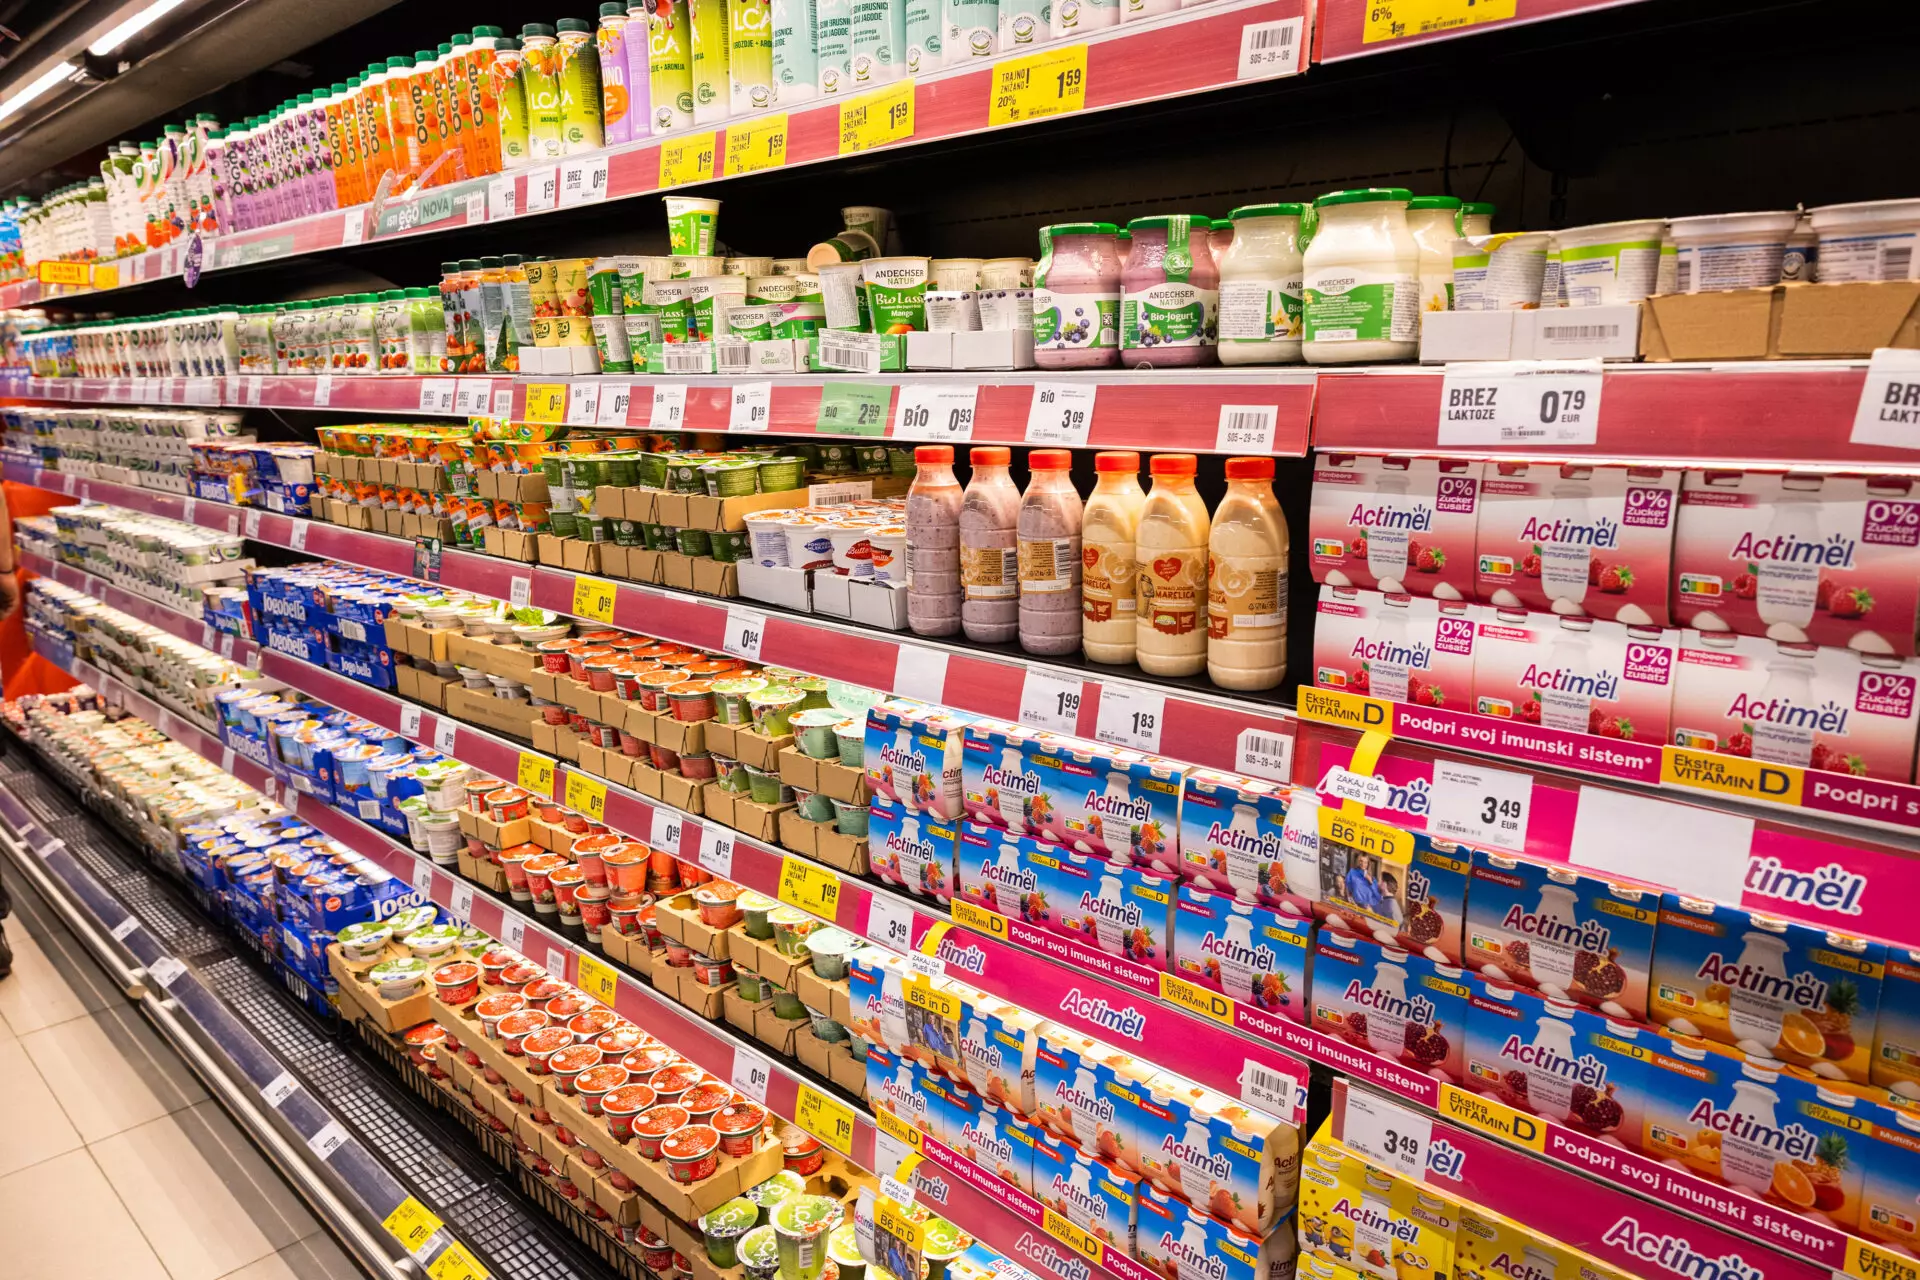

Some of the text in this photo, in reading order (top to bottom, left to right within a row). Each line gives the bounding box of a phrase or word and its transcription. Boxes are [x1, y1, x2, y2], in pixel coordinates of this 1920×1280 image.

[1371, 8, 1392, 22] 6%
[997, 96, 1016, 108] 20%
[1068, 87, 1080, 96] EUR
[567, 169, 582, 182] BREZ
[422, 198, 449, 217] NOVA
[875, 269, 924, 279] ANDECHSER
[887, 277, 915, 285] NATUR
[1149, 289, 1194, 299] ANDECHSER
[1159, 298, 1184, 307] NATUR
[890, 309, 913, 318] Mango
[1448, 386, 1498, 407] BREZ
[1447, 407, 1496, 421] LAKTOZE
[1560, 413, 1580, 423] EUR
[1438, 494, 1473, 504] Zucker
[1440, 479, 1474, 496] 0%
[1438, 502, 1472, 512] zusatz
[1627, 489, 1669, 510] 0%
[1350, 503, 1432, 531] Actimel
[1625, 514, 1667, 528] zusatz
[1626, 506, 1668, 519] Zucker
[1867, 502, 1919, 526] 0%
[1521, 517, 1618, 547] Actimel
[1732, 532, 1854, 568] Actimel
[1156, 590, 1195, 600] MARELICA
[1437, 634, 1471, 646] Zucker
[1440, 620, 1472, 638] 0%
[1352, 636, 1431, 669] Actimel
[1436, 642, 1470, 653] zusatz
[1628, 645, 1669, 666] 0%
[1626, 662, 1668, 675] Zucker
[1626, 670, 1666, 683] zusatz
[1520, 664, 1619, 700] Actimel
[1862, 674, 1911, 697] 0%
[1305, 693, 1340, 708] Ekstra
[1305, 702, 1384, 725] VITAMIN D
[1727, 692, 1848, 734] Actimel
[1400, 712, 1456, 735] Podpri
[1461, 726, 1496, 746] svoj
[1502, 732, 1574, 756] imunski
[880, 743, 925, 773] Actimel
[1674, 753, 1725, 773] Ekstra
[983, 764, 1040, 793] Actimel
[1336, 774, 1380, 793] ZAKAJ GA
[1674, 767, 1791, 795] VITAMIN D
[1084, 790, 1151, 821] Actimel
[1813, 782, 1899, 811] Podpri
[1207, 823, 1281, 862] Actimel
[1331, 824, 1395, 856] B6 in D
[1476, 868, 1522, 888] Granatapfel
[955, 903, 977, 917] Ekstra
[1080, 891, 1141, 927] Actimel
[955, 910, 1003, 933] VITAMIN D
[1503, 903, 1609, 954] Actimel
[1011, 926, 1045, 950] Podpri
[1047, 940, 1068, 956] svoj
[1070, 947, 1111, 971] imunski
[1201, 931, 1274, 972] Actimel
[1320, 946, 1359, 964] Granatapfel
[1166, 979, 1194, 996] Ekstra
[1696, 952, 1829, 1011] Actimel
[1167, 987, 1228, 1017] VITAMIN D
[1344, 979, 1435, 1027] Actimel
[1473, 998, 1520, 1017] Granatapfel
[1060, 988, 1146, 1041] Actimel
[1239, 1011, 1282, 1037] Podpri
[1286, 1031, 1313, 1051] svoj
[1317, 1042, 1372, 1073] imunski
[1501, 1035, 1606, 1090] Actimel
[1657, 1057, 1707, 1078] Multifrucht
[1450, 1092, 1488, 1116] Ekstra
[879, 1119, 919, 1145] VITAMIN D
[1448, 1101, 1537, 1142] VITAMIN D
[1690, 1099, 1816, 1163] Actimel
[925, 1140, 952, 1168] Podpri
[954, 1158, 971, 1178] svoj
[973, 1169, 1006, 1197] imunski
[1553, 1135, 1616, 1170] Podpri
[1621, 1161, 1661, 1190] svoj
[1666, 1178, 1746, 1220] imunski
[1332, 1199, 1419, 1245] Actimel
[1047, 1224, 1098, 1256] VITAMIN D
[1106, 1252, 1142, 1280] Podpri
